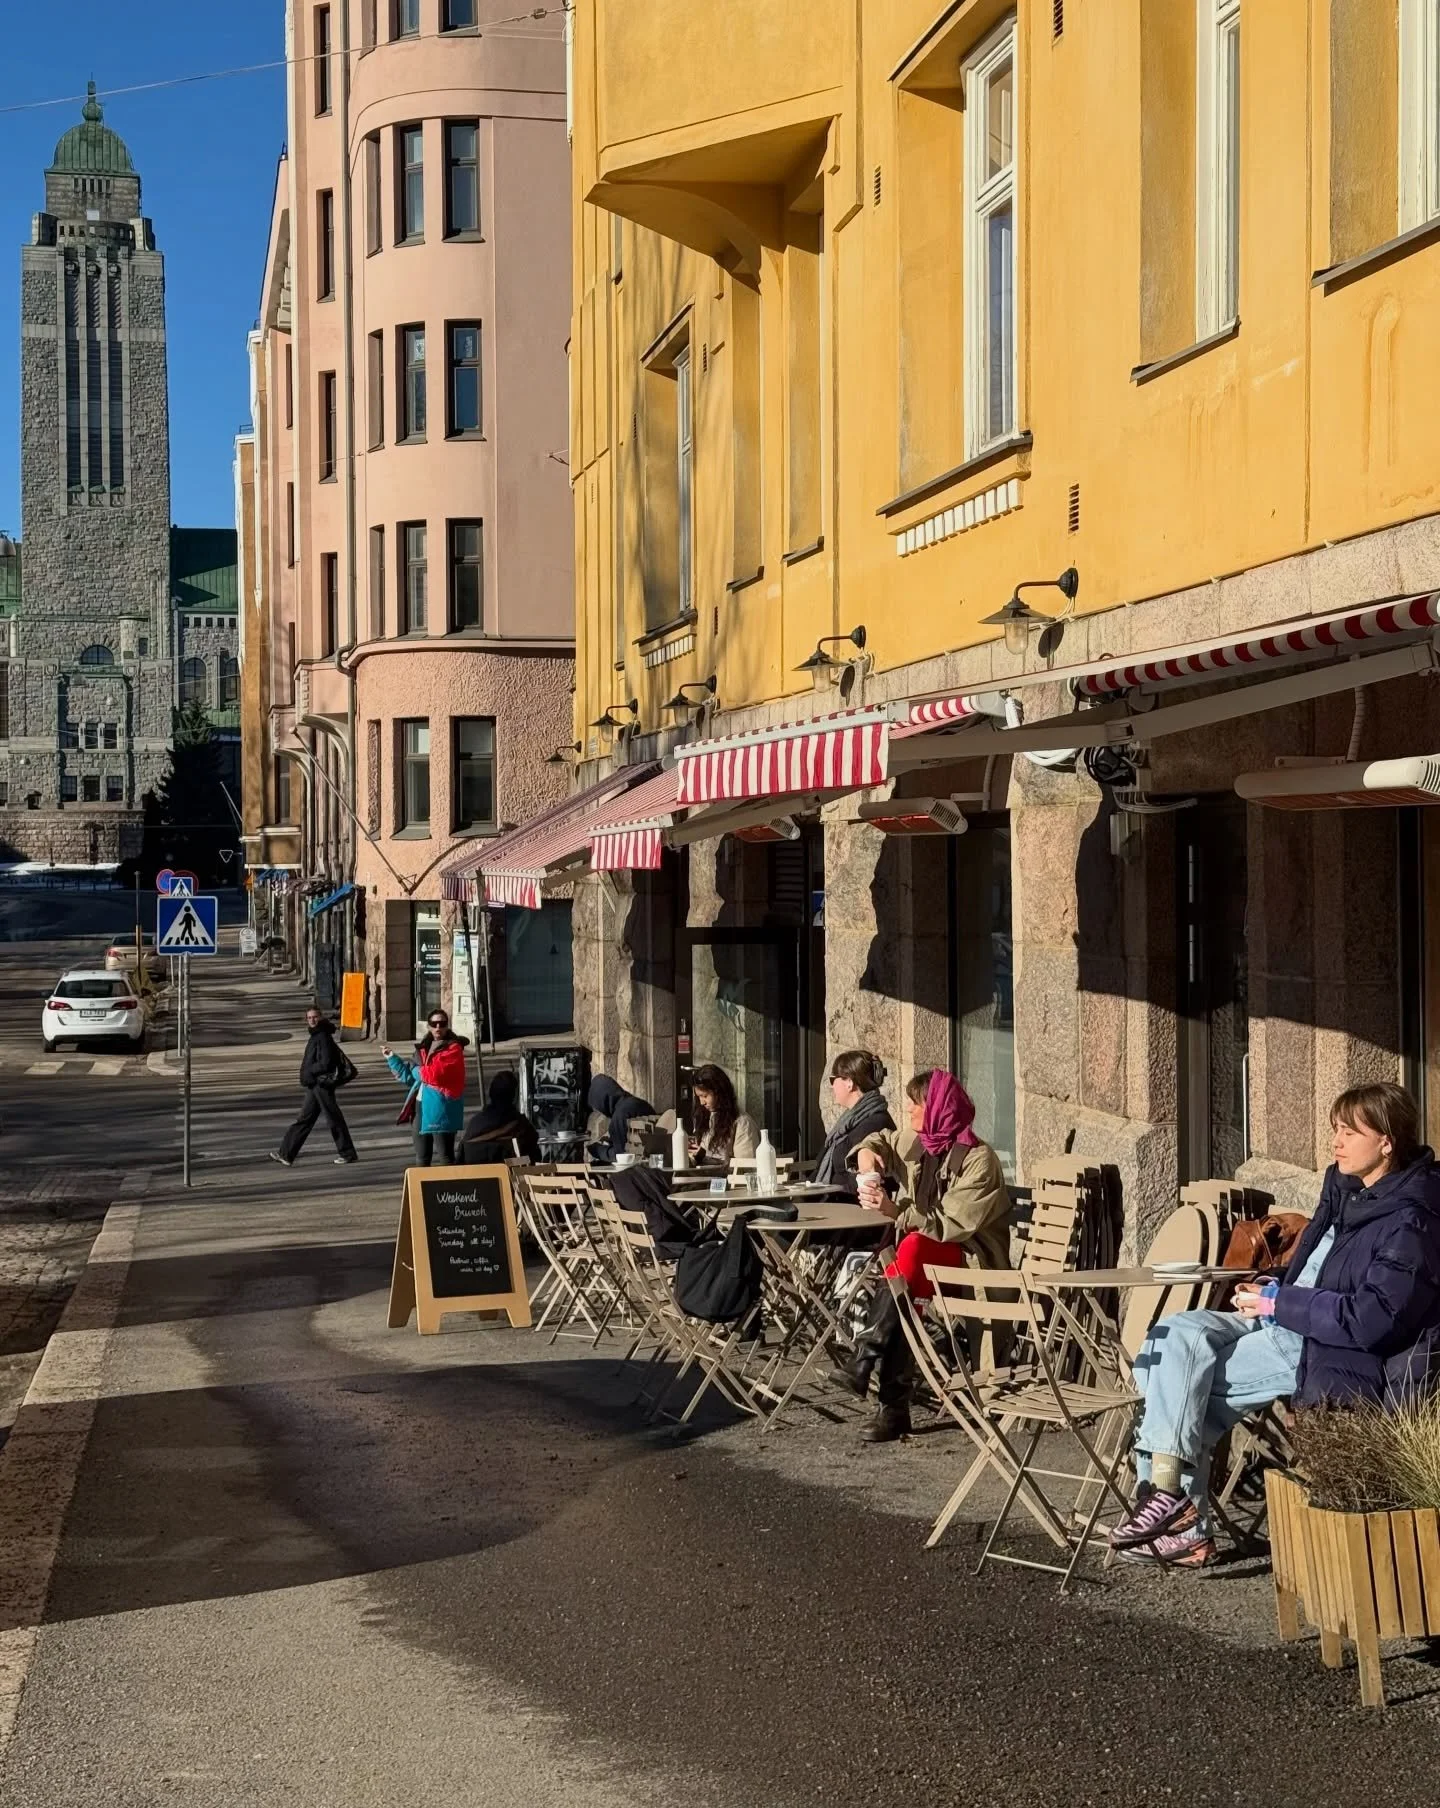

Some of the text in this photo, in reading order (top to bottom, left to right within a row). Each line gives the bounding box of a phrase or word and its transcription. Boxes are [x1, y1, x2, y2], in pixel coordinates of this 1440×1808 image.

[436, 1188, 478, 1203] Weekend
[454, 1204, 487, 1220] Brunch
[436, 1225, 466, 1237] Saturday
[438, 1238, 464, 1248] Sunday
[481, 1235, 495, 1247] day!
